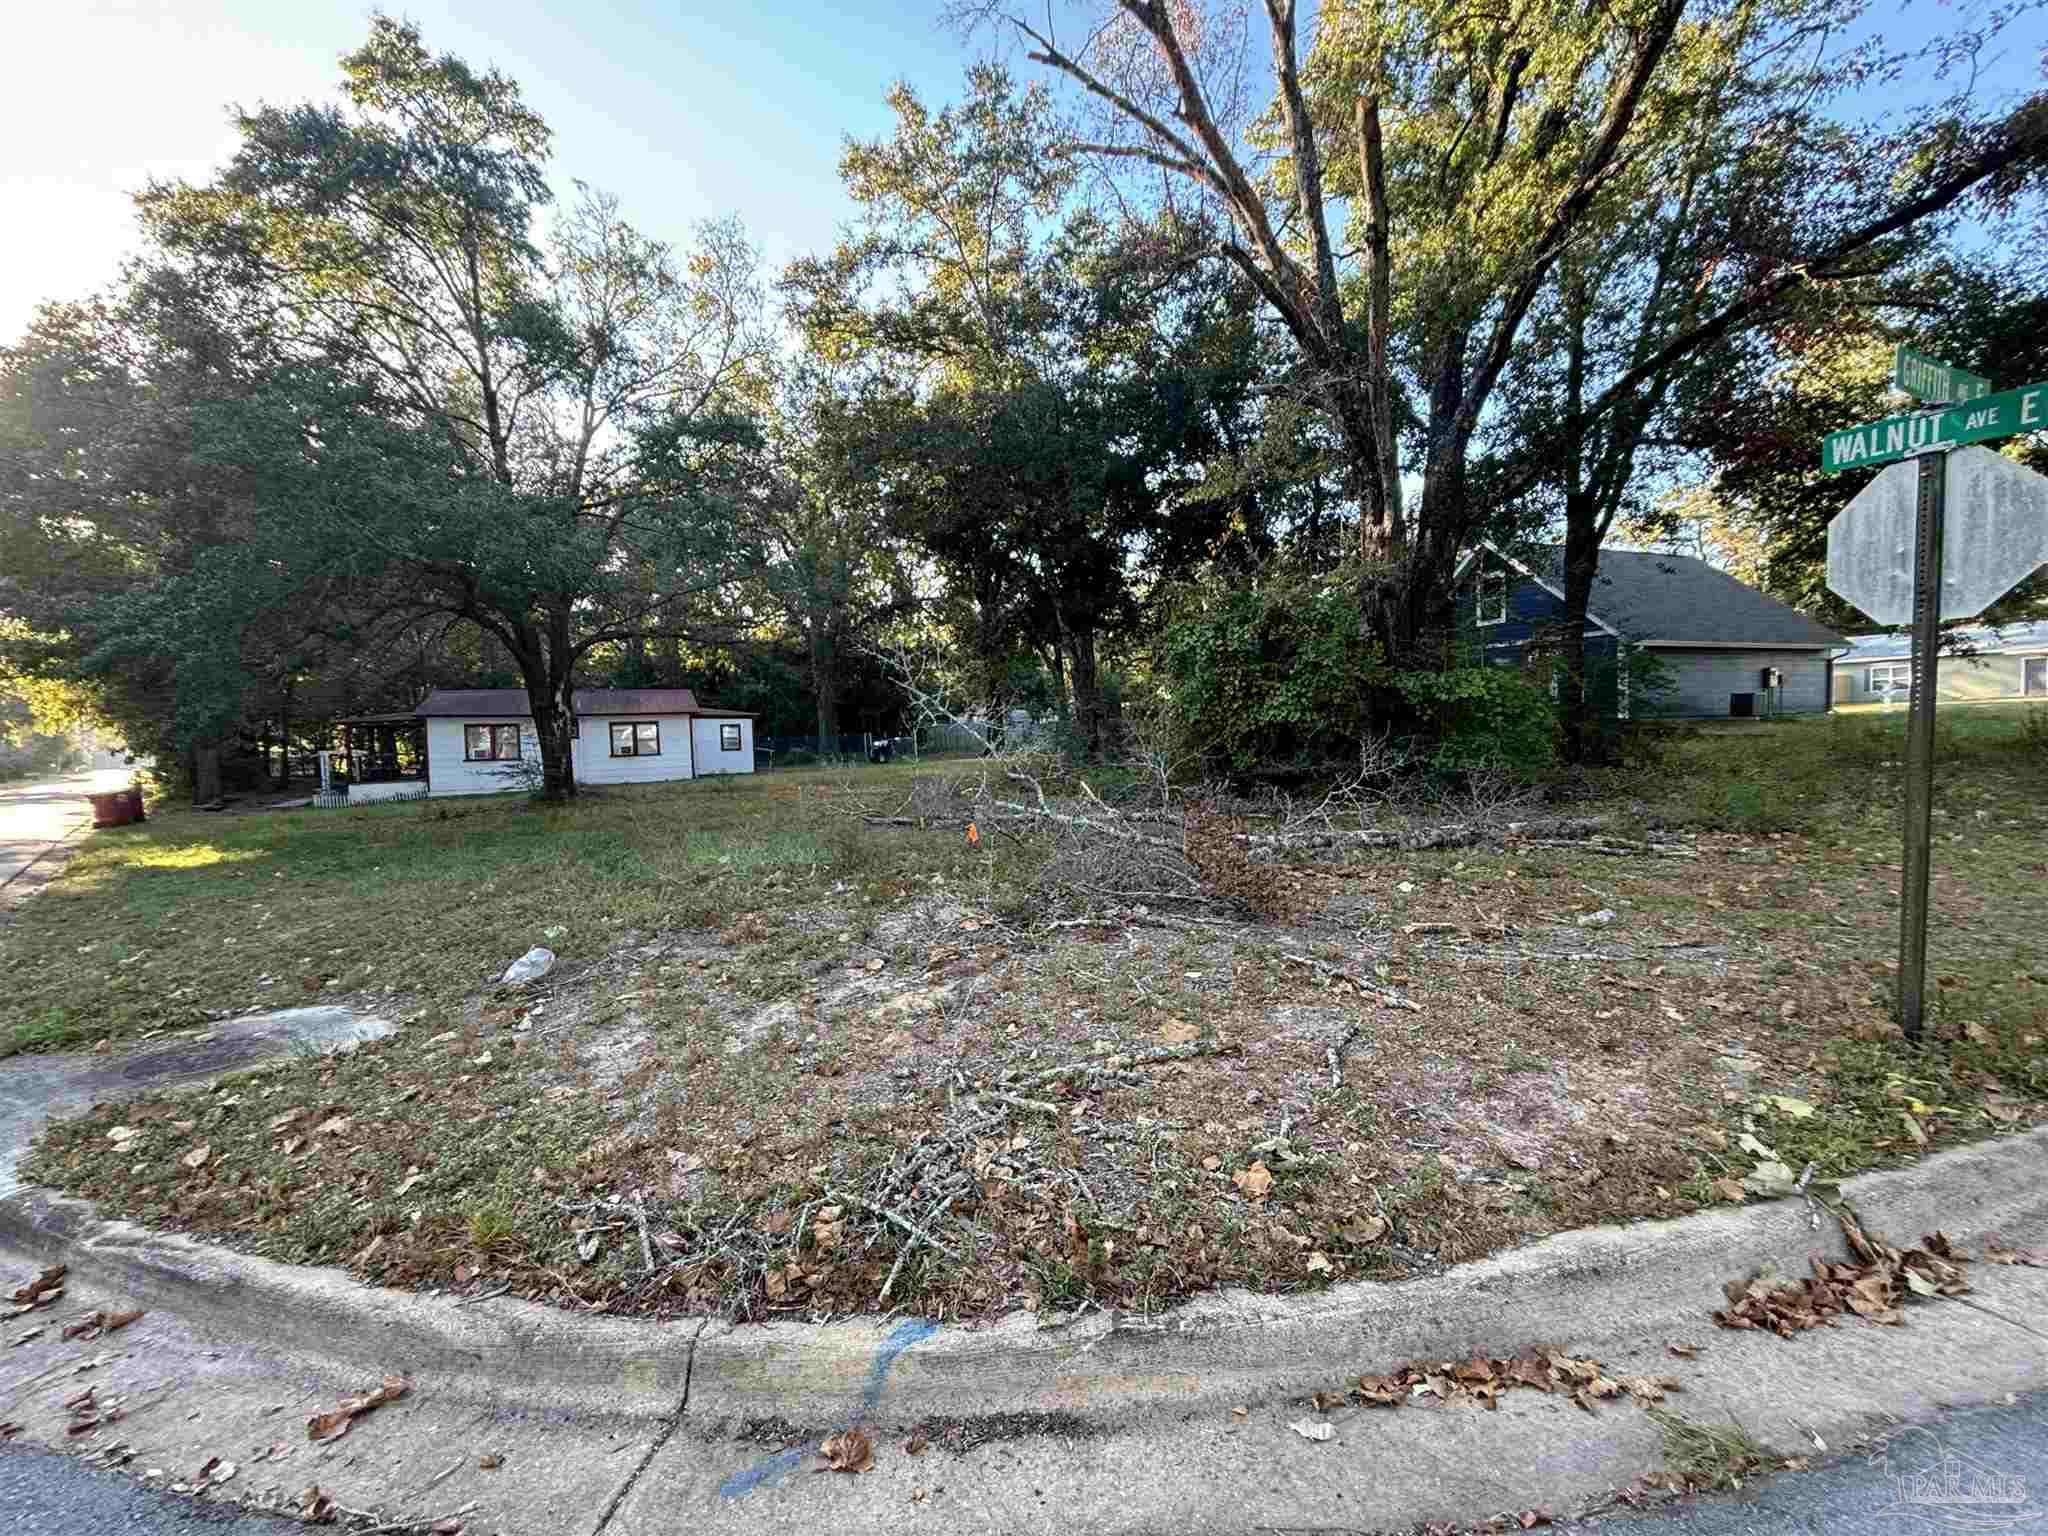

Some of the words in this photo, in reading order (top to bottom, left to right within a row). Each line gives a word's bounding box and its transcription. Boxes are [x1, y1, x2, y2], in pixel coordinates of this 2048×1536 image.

[1832, 413, 1945, 465] WALNUT
[1966, 407, 2000, 431] AVE
[2021, 391, 2041, 425] E
